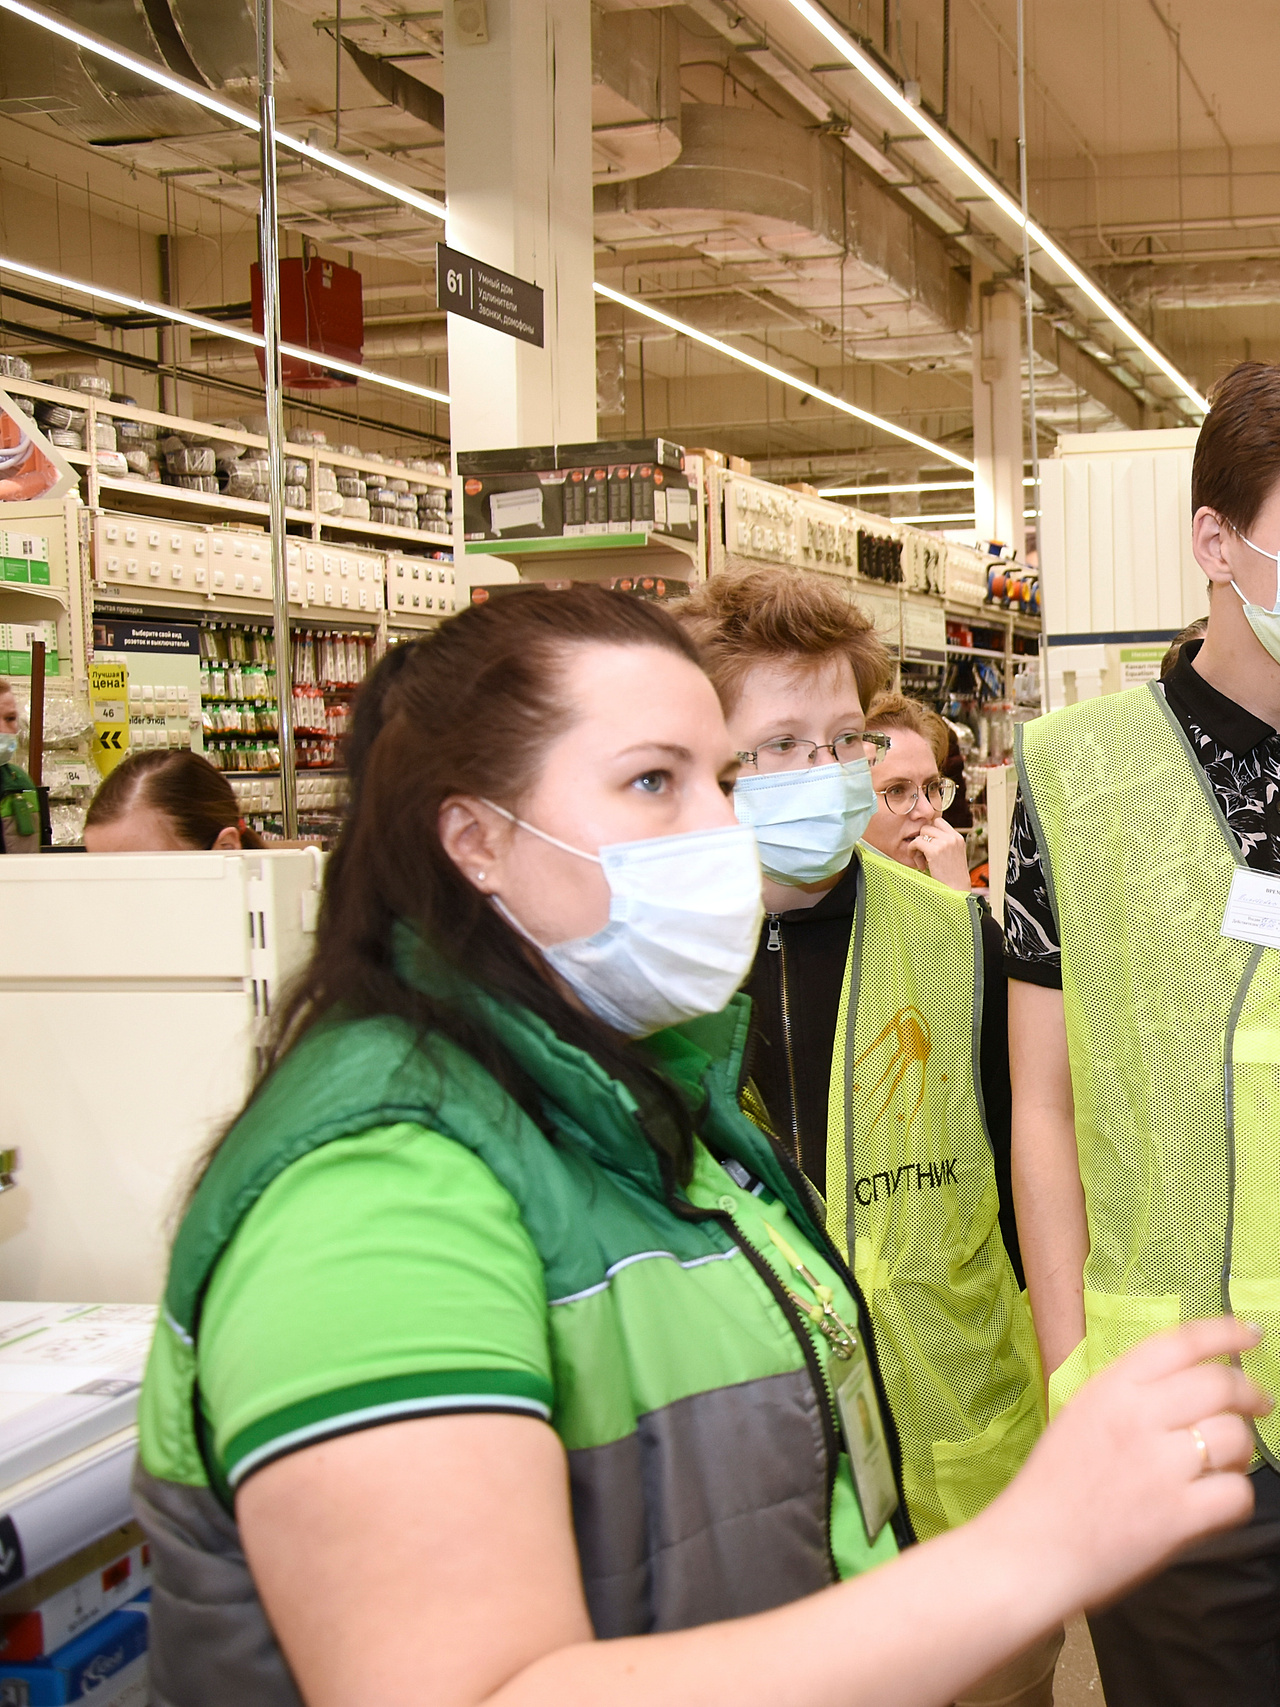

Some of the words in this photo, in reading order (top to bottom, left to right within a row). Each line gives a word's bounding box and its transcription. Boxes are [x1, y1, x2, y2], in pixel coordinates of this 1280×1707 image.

[446, 268, 463, 296] 61
[477, 271, 500, 290] Умный
[500, 283, 514, 295] дом
[477, 287, 518, 313] Удлинители
[503, 315, 535, 335] домофоны
[94, 604, 115, 612] крытая
[131, 629, 158, 638] Выберите
[172, 632, 182, 640] вид
[124, 638, 145, 646] розеток
[151, 639, 190, 648] выключателей
[92, 671, 120, 679] Лучшая
[103, 708, 114, 718] 46
[146, 716, 166, 726] Этюд
[854, 1158, 960, 1206] СПУТНИК
